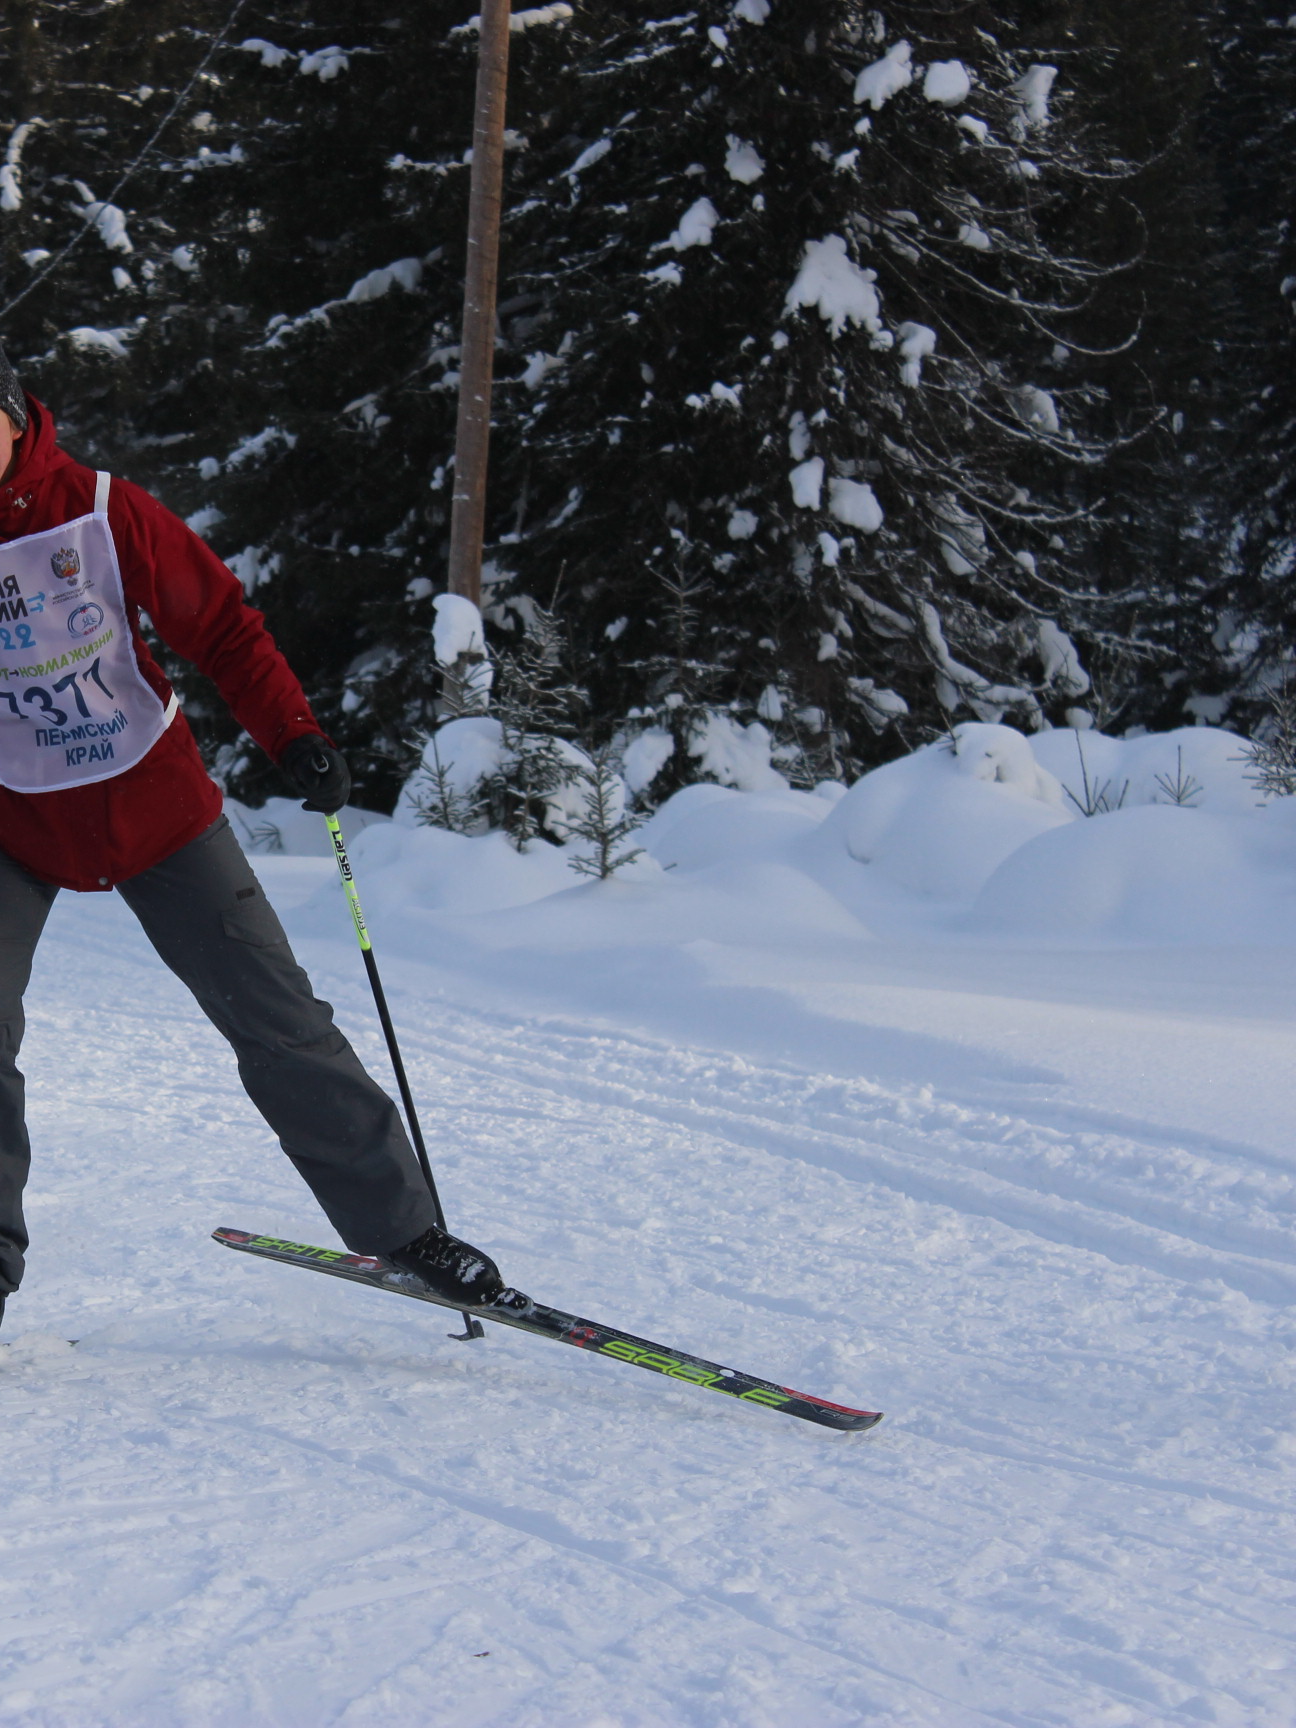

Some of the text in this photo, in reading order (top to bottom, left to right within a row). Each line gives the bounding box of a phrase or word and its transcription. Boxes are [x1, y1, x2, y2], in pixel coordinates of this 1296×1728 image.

[18, 653, 70, 678] НОРМА
[68, 628, 114, 664] ЖИЗНИ
[35, 708, 129, 747] ПЕРМСКИЙ
[65, 738, 115, 767] КРАЙ
[332, 830, 353, 881] Larsen
[250, 1236, 347, 1262] SKATE
[599, 1341, 791, 1409] SABLE
